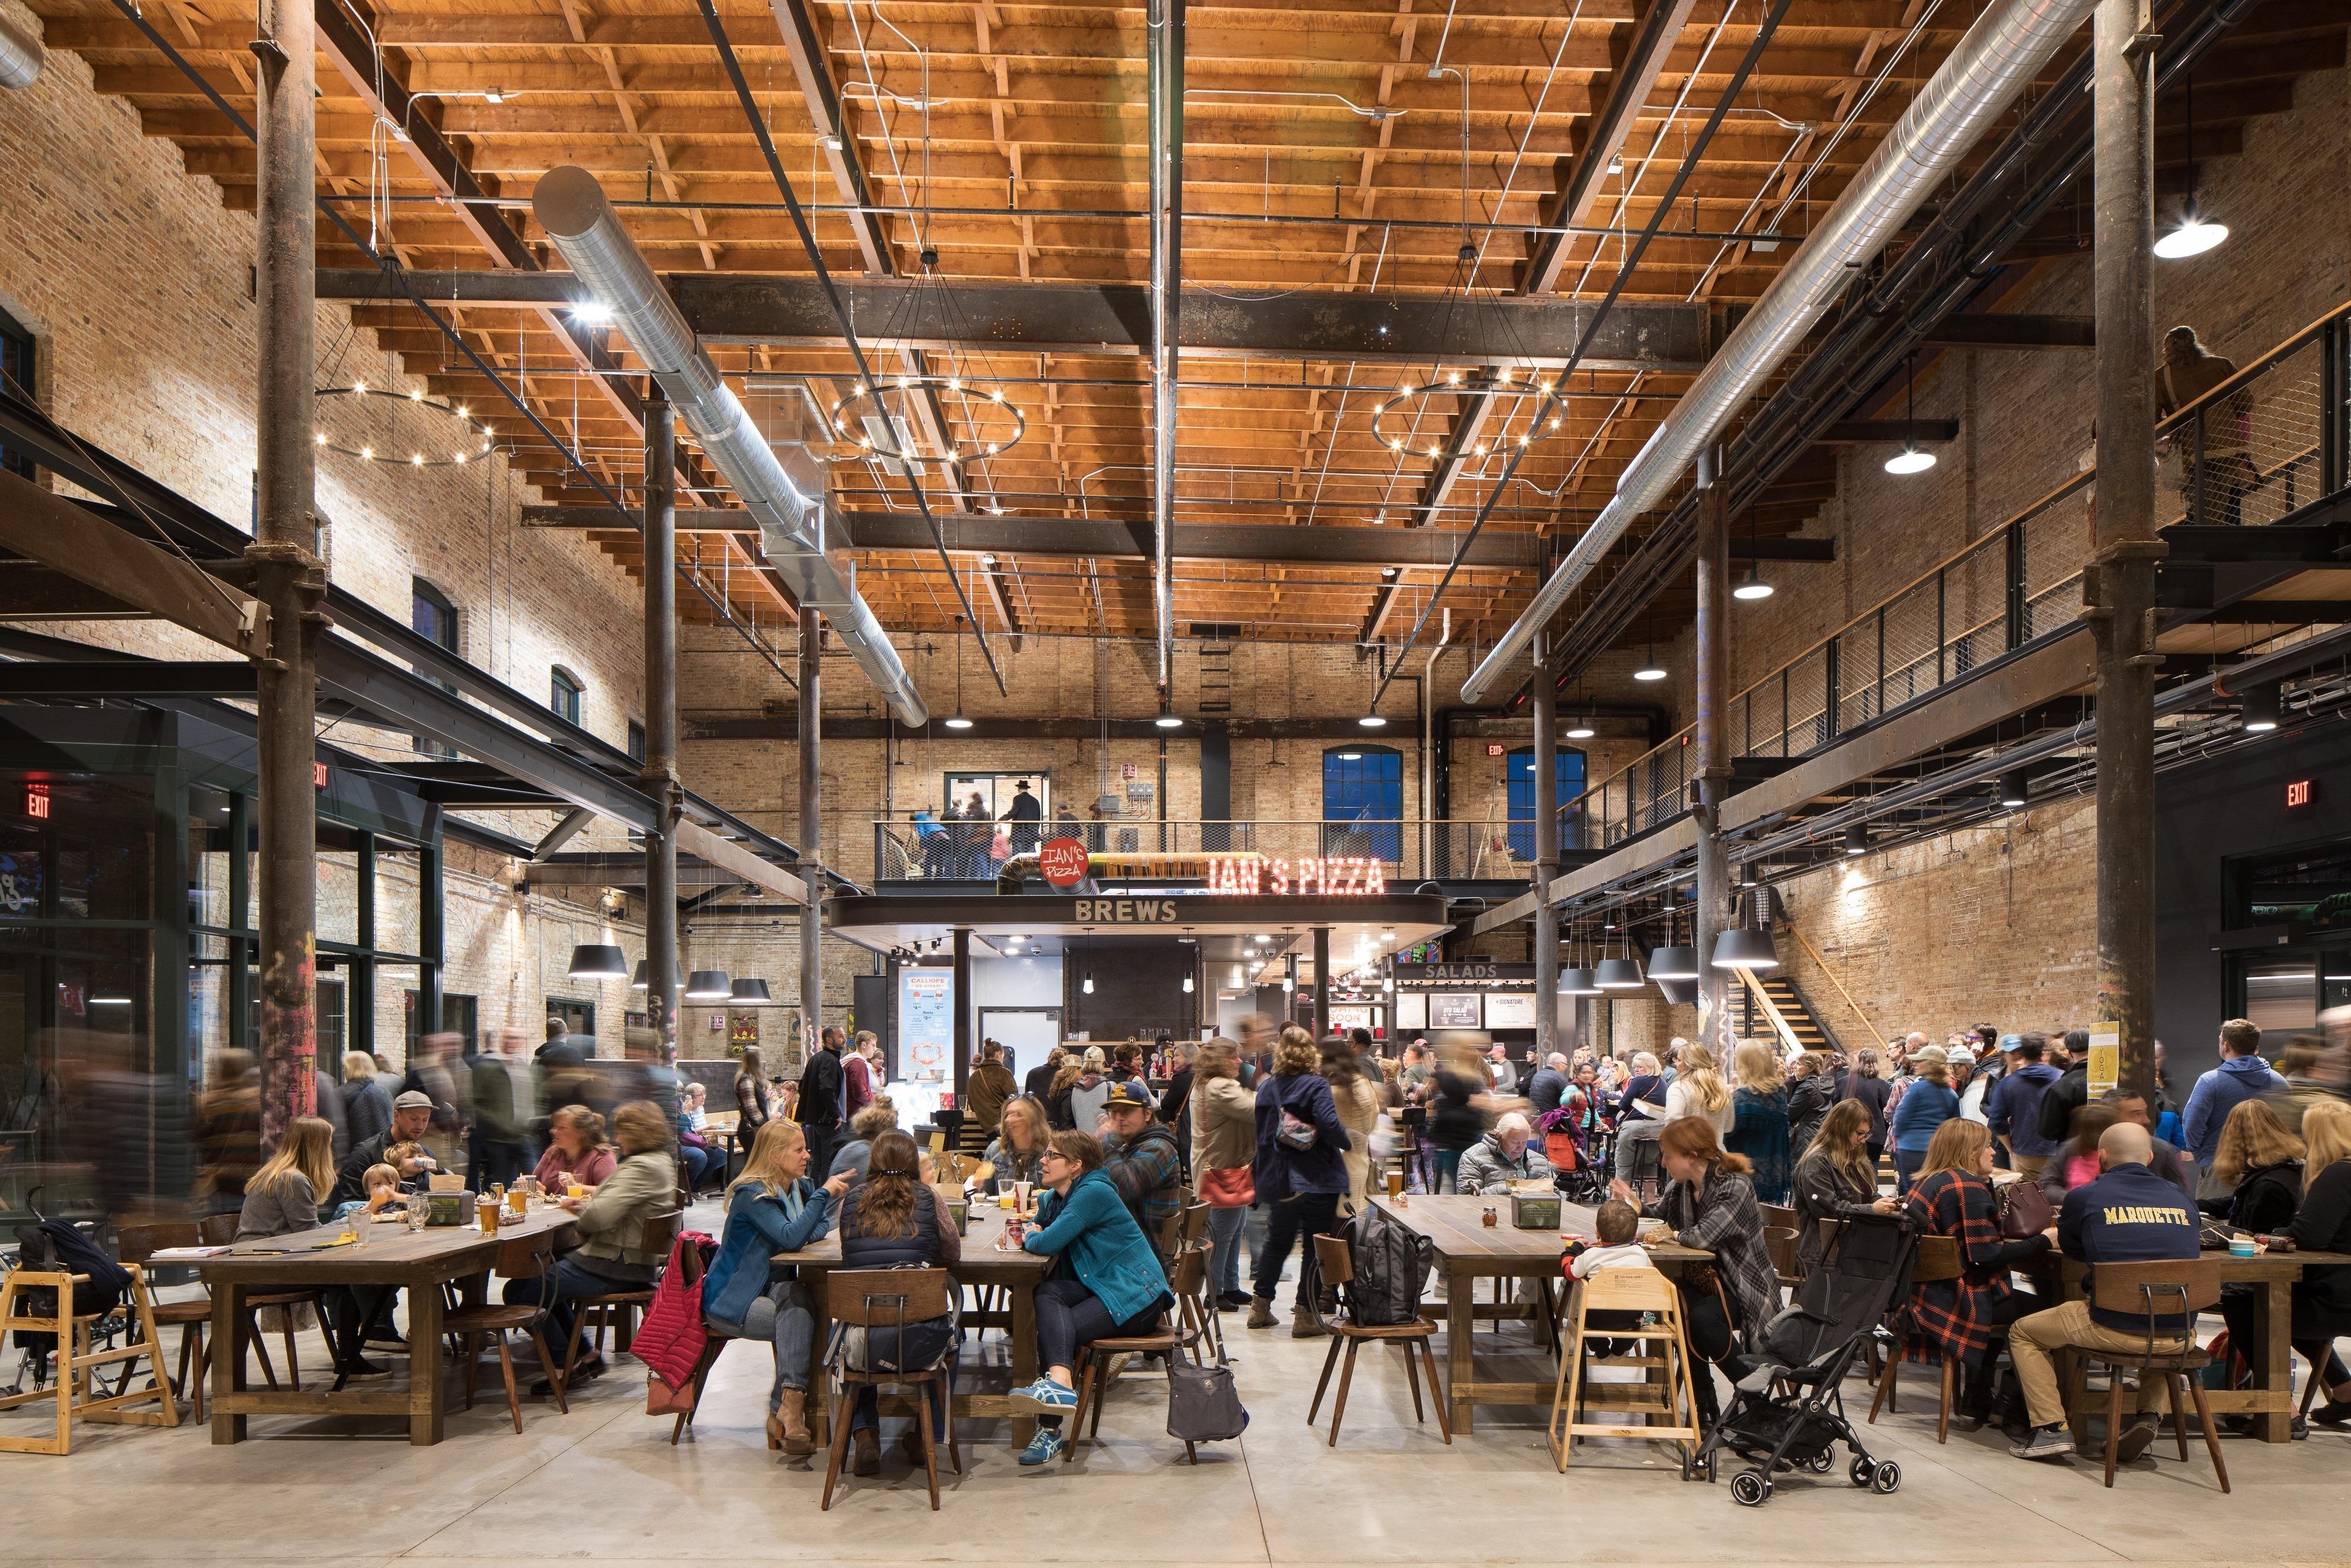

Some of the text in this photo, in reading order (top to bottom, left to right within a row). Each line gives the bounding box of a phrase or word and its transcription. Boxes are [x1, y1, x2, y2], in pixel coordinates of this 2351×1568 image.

[1489, 745, 1501, 755] EXIT
[2288, 781, 2309, 806] EXIT
[29, 793, 49, 818] EXIT
[1042, 845, 1084, 864] IAN'S
[1209, 857, 1385, 895] IAN'S PIZZA
[1075, 900, 1177, 922] BREWS
[1425, 965, 1497, 978] SALADS
[2103, 1206, 2191, 1226] MARQUETTE
